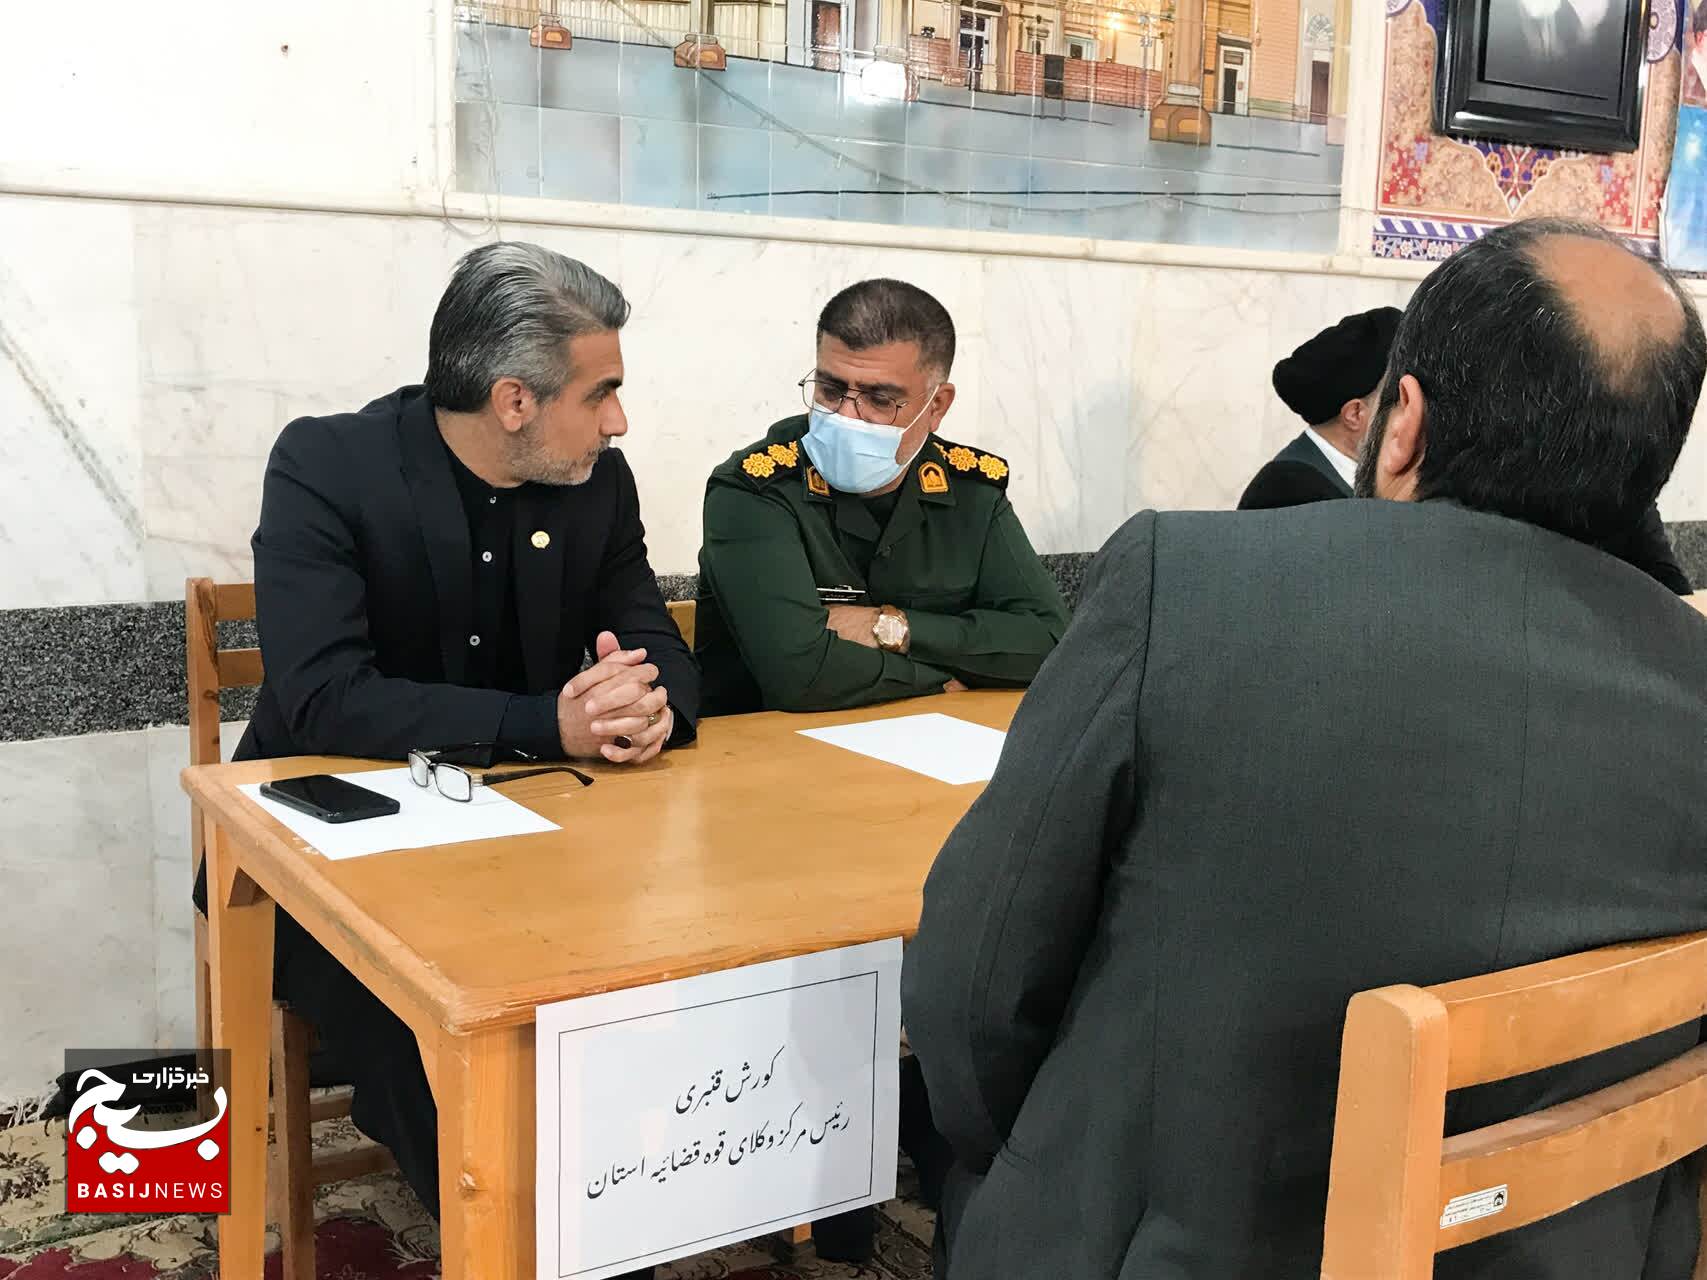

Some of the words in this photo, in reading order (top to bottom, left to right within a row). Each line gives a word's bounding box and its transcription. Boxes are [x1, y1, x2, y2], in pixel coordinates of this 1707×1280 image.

[675, 1068, 723, 1115] قنبری
[723, 1045, 785, 1104] کورش
[727, 1119, 775, 1166] وکلای
[776, 1101, 807, 1153] مرکز
[809, 1099, 851, 1145] رئیس
[649, 1140, 702, 1184] قضائیه
[703, 1129, 727, 1165] قوه
[586, 1155, 646, 1200] استان
